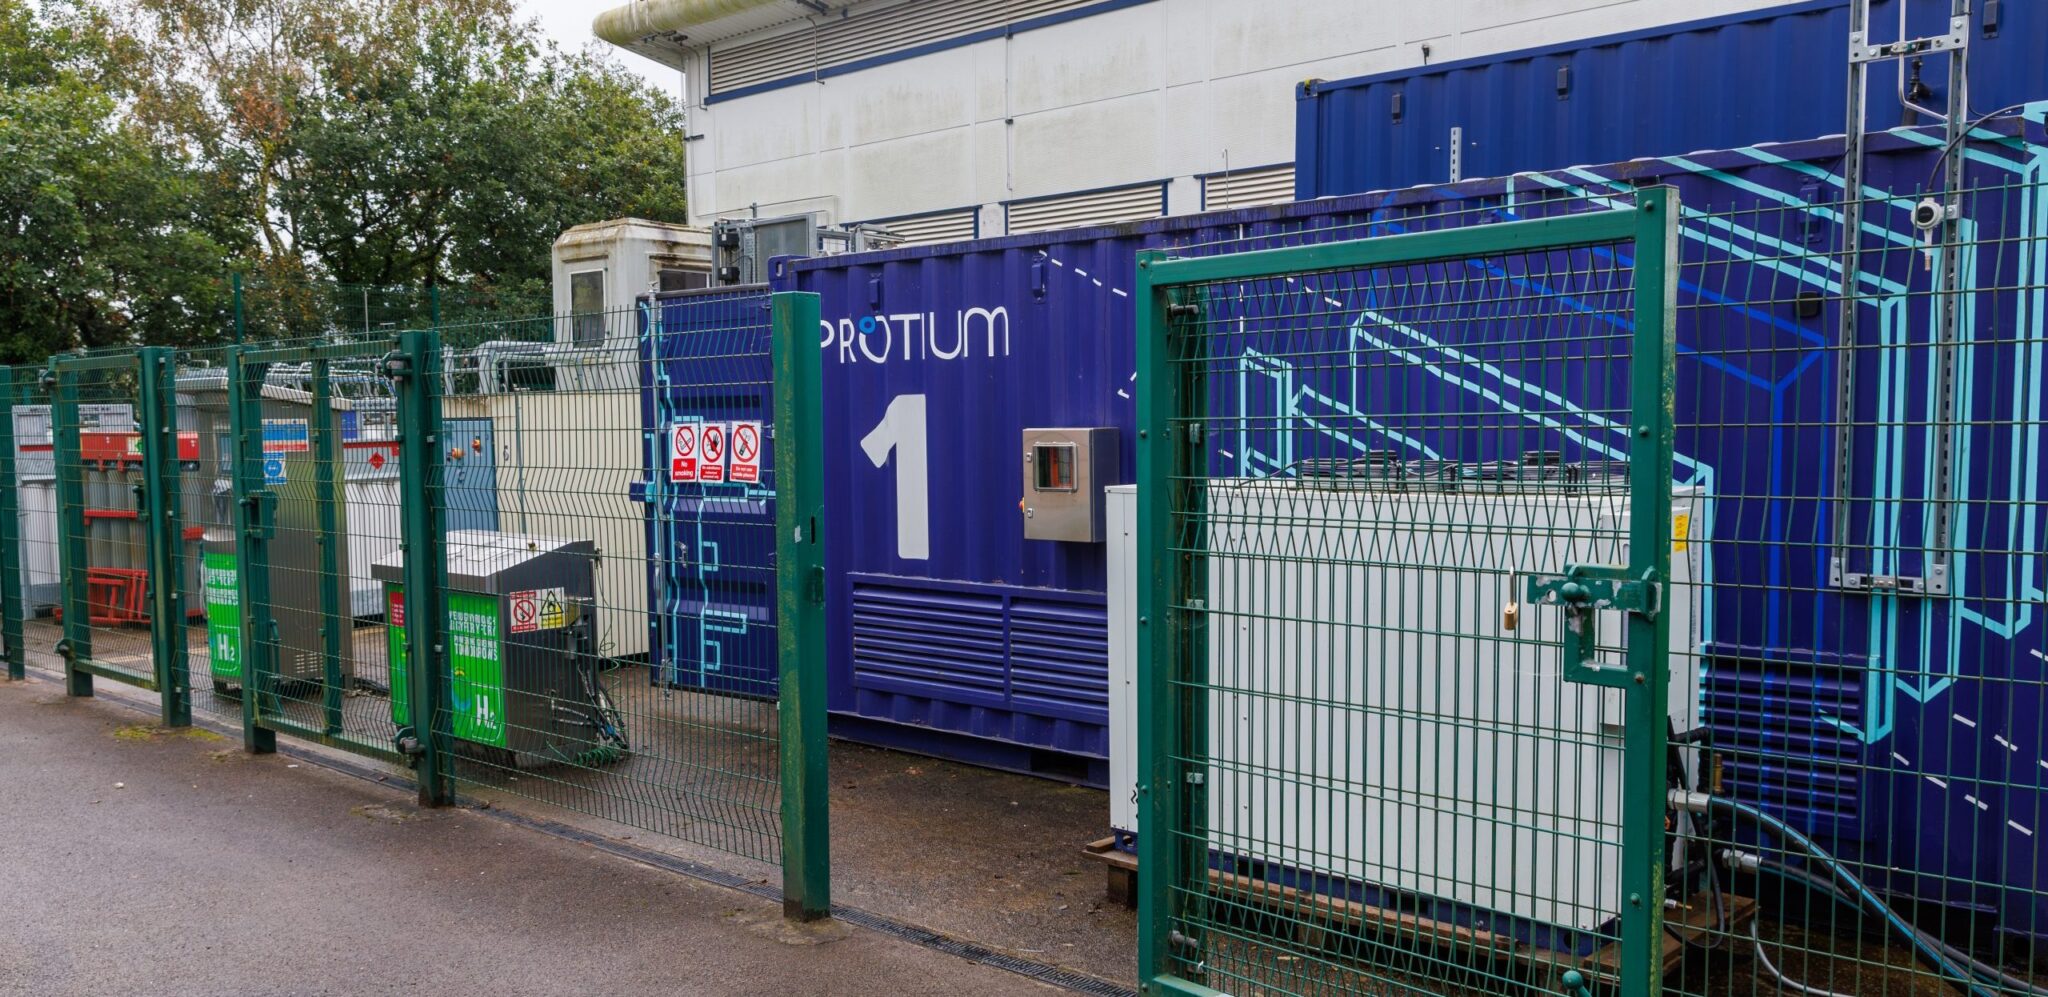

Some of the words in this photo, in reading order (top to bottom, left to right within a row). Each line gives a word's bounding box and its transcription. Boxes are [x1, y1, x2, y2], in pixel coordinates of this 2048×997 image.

[820, 306, 1010, 364] PROTIUM
[674, 469, 694, 477] smoking
[860, 394, 930, 560] 1
